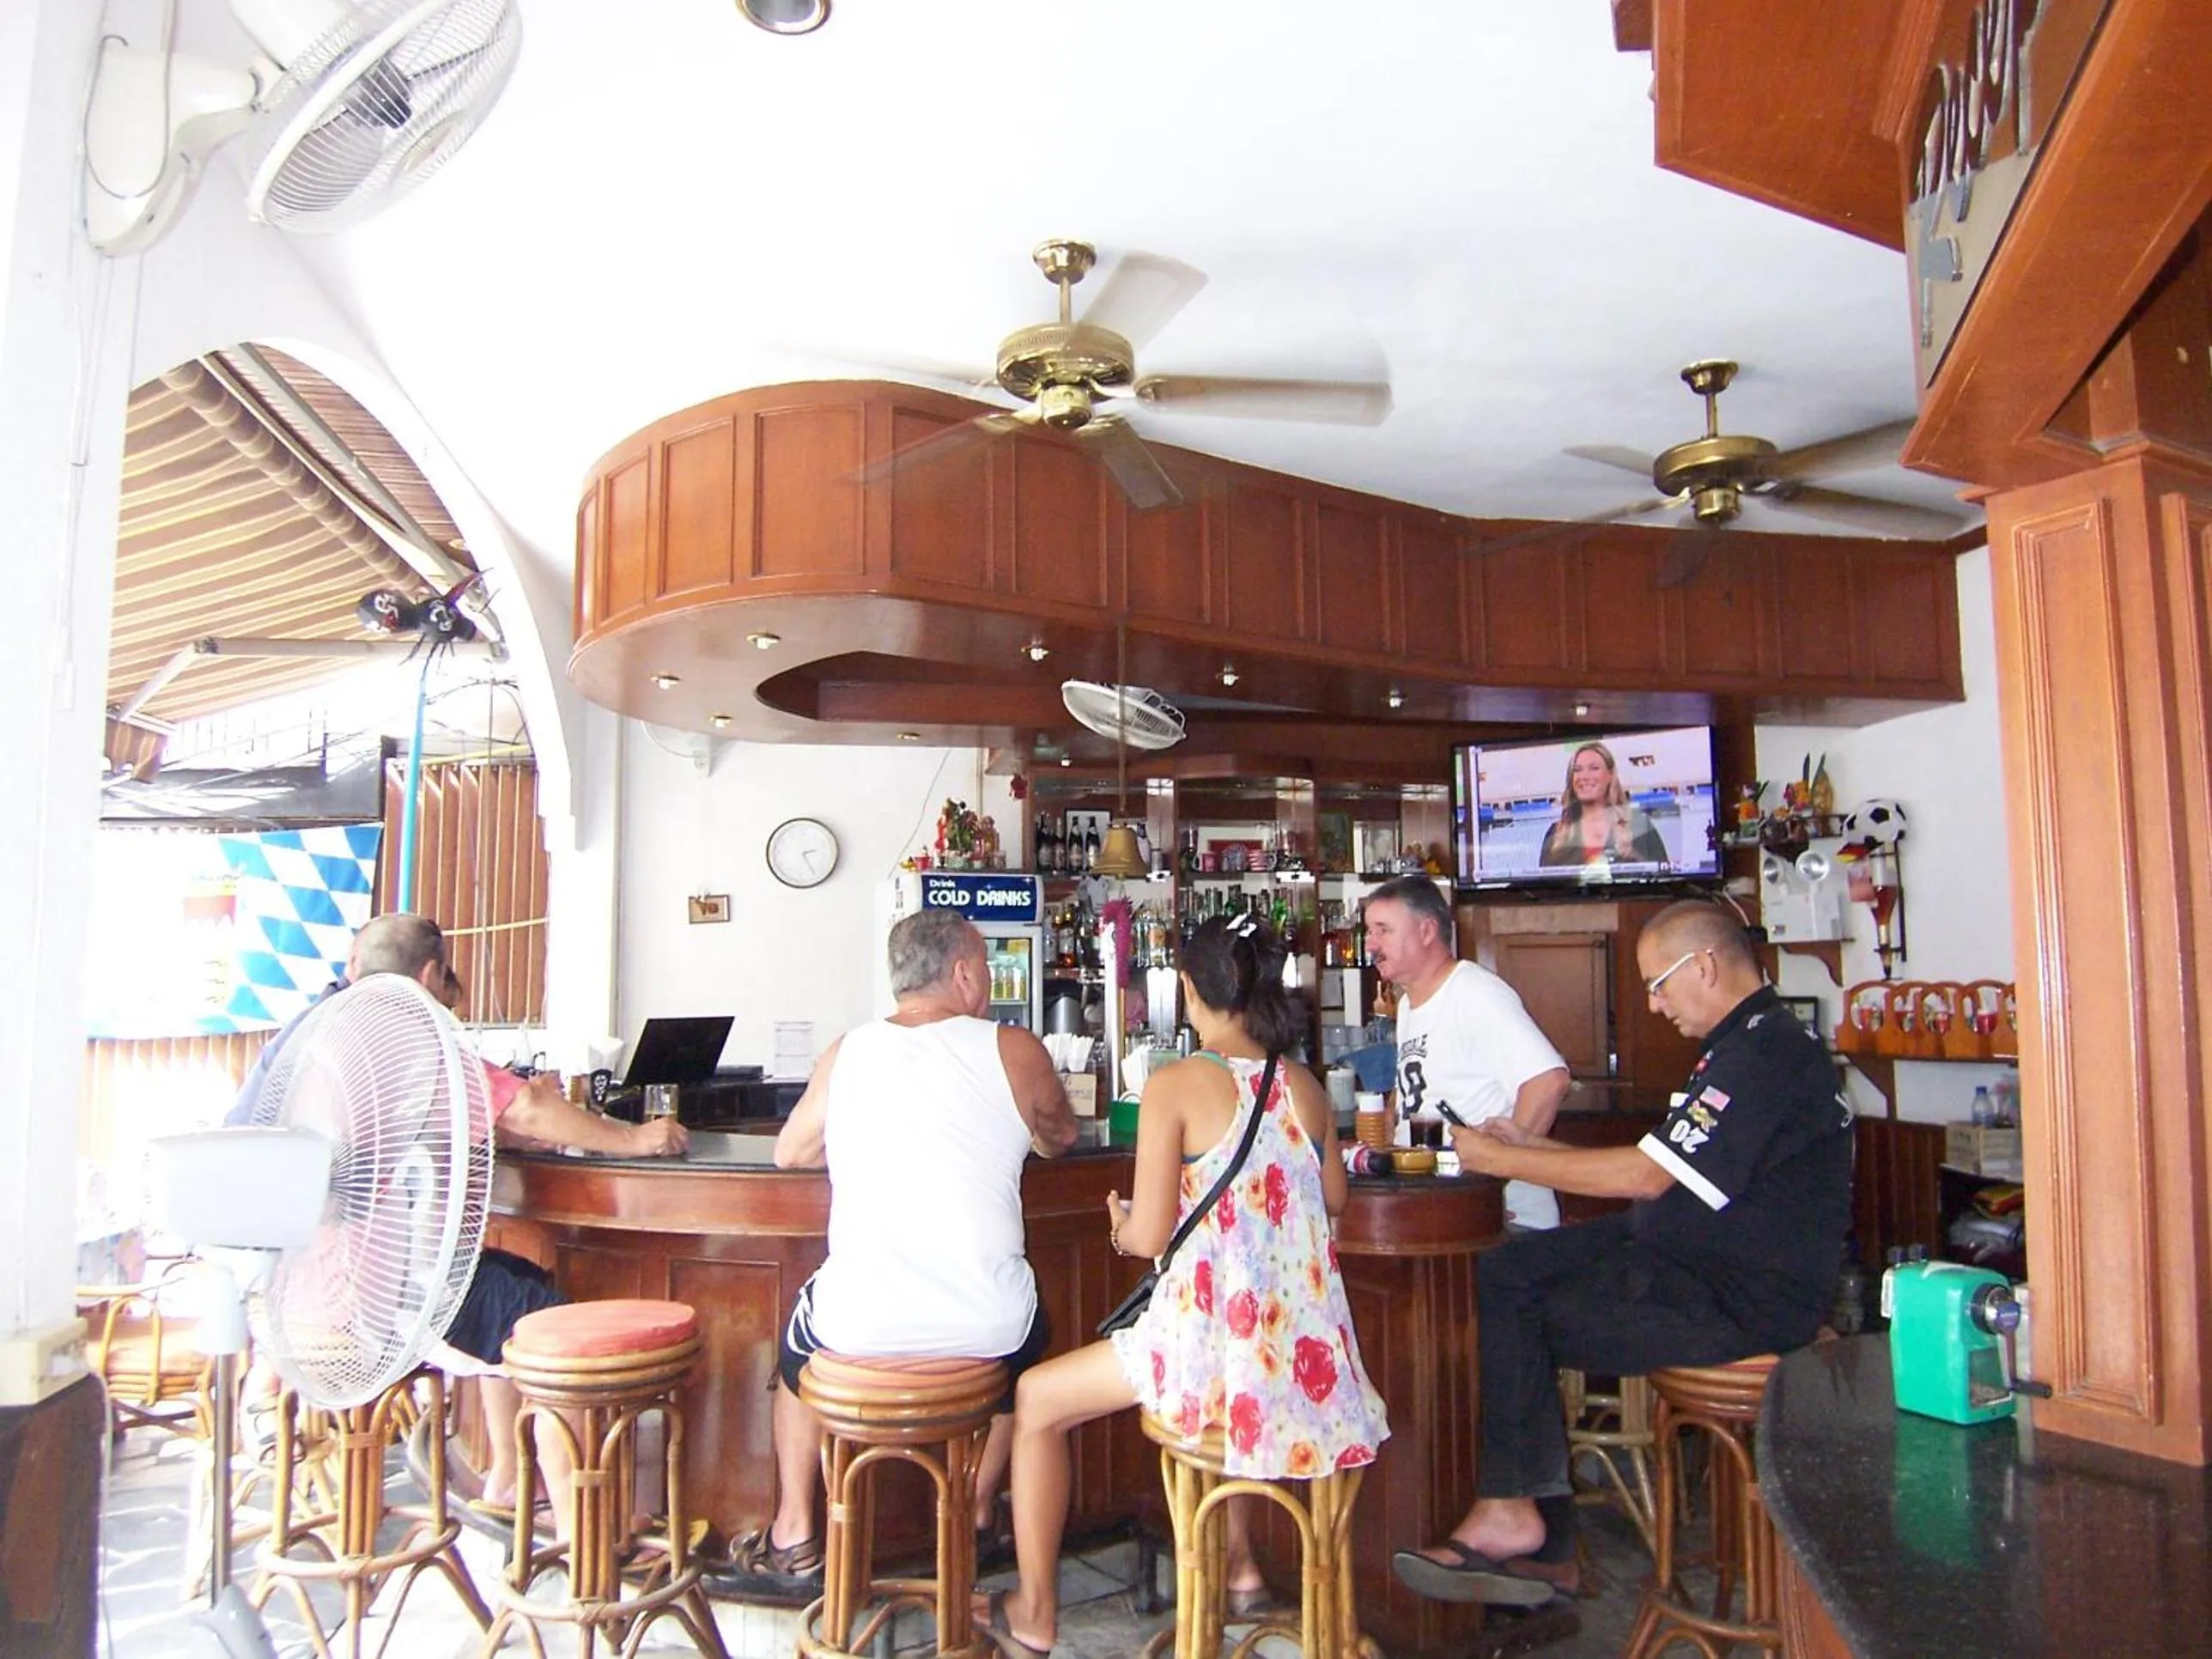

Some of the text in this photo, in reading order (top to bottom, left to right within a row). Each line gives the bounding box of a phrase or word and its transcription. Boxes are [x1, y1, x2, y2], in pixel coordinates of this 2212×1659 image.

[929, 879, 956, 888] Drink
[928, 890, 1031, 907] COLD DRINKS
